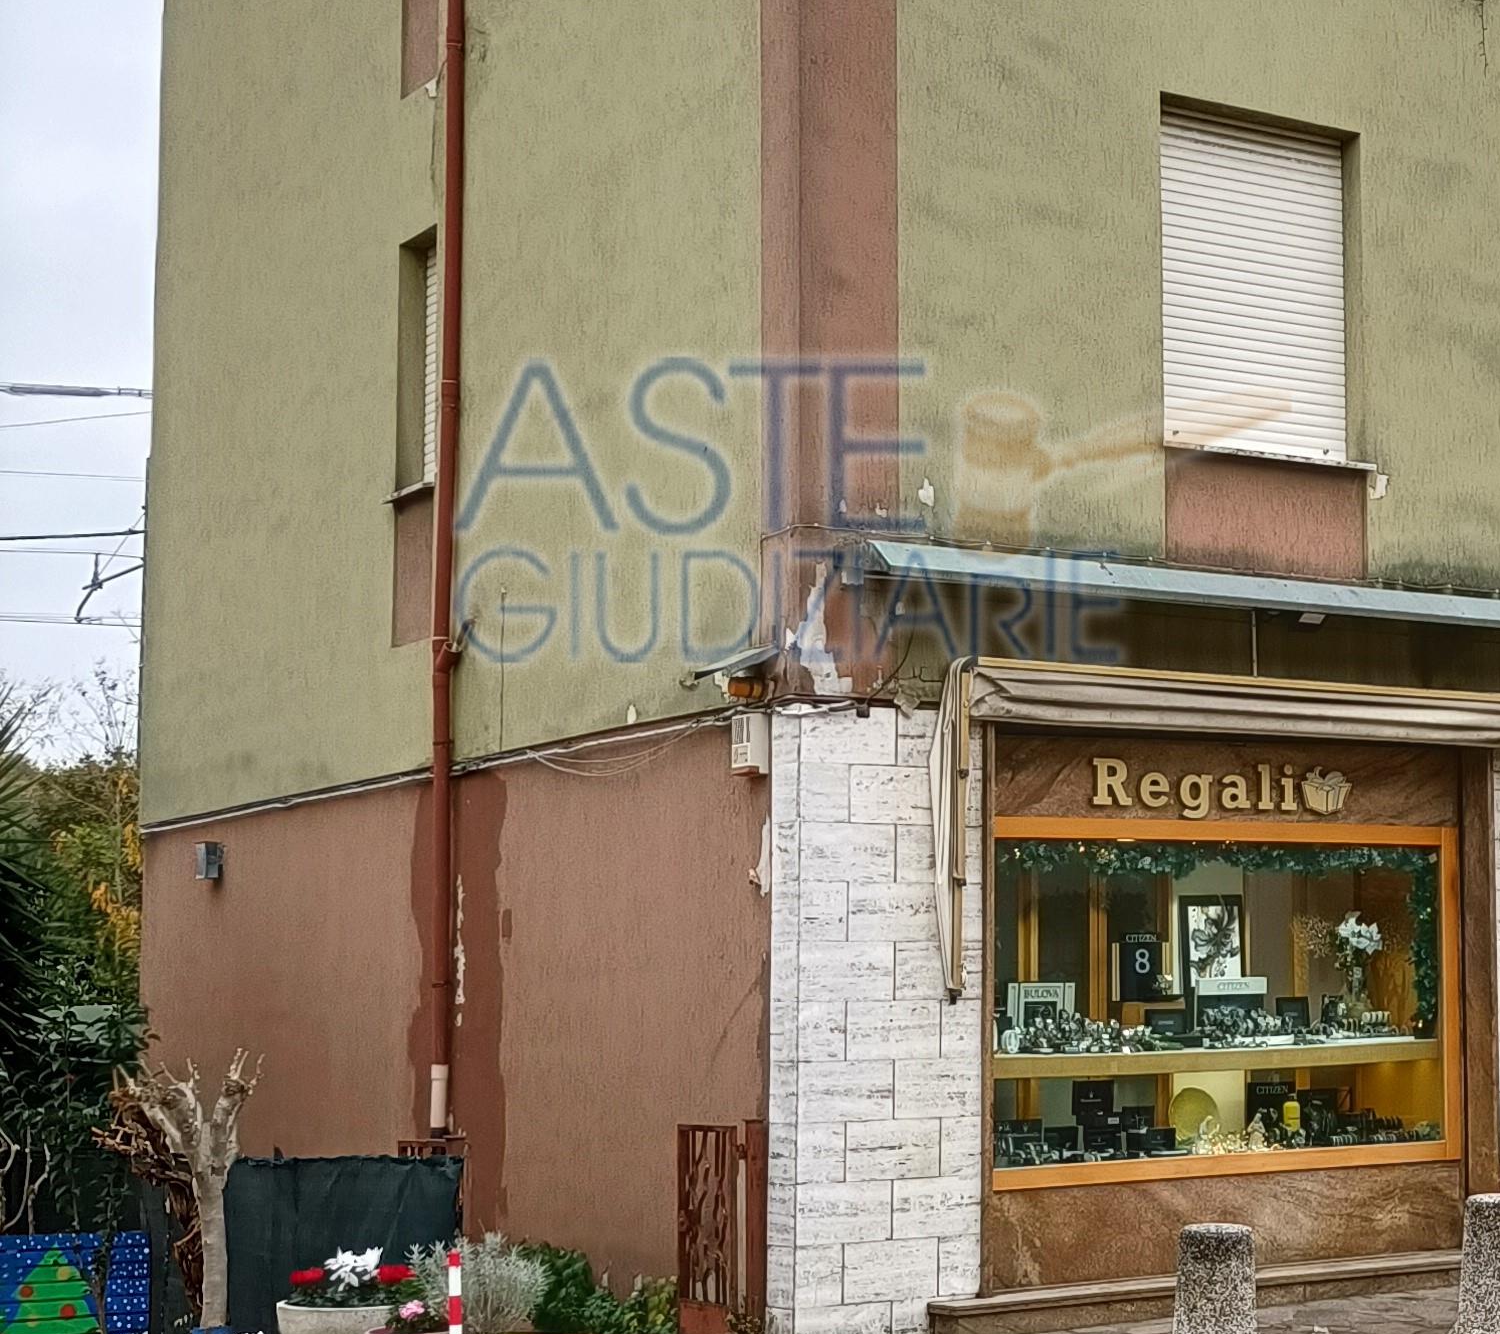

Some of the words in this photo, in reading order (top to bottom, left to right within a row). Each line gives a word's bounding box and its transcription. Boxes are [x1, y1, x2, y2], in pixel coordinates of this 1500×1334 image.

[1092, 757, 1298, 818] Regali
[1125, 934, 1157, 942] CITIZEN
[1135, 948, 1150, 974] 8
[1023, 988, 1060, 999] BULOVA
[1256, 1085, 1289, 1095] CITIZEN
